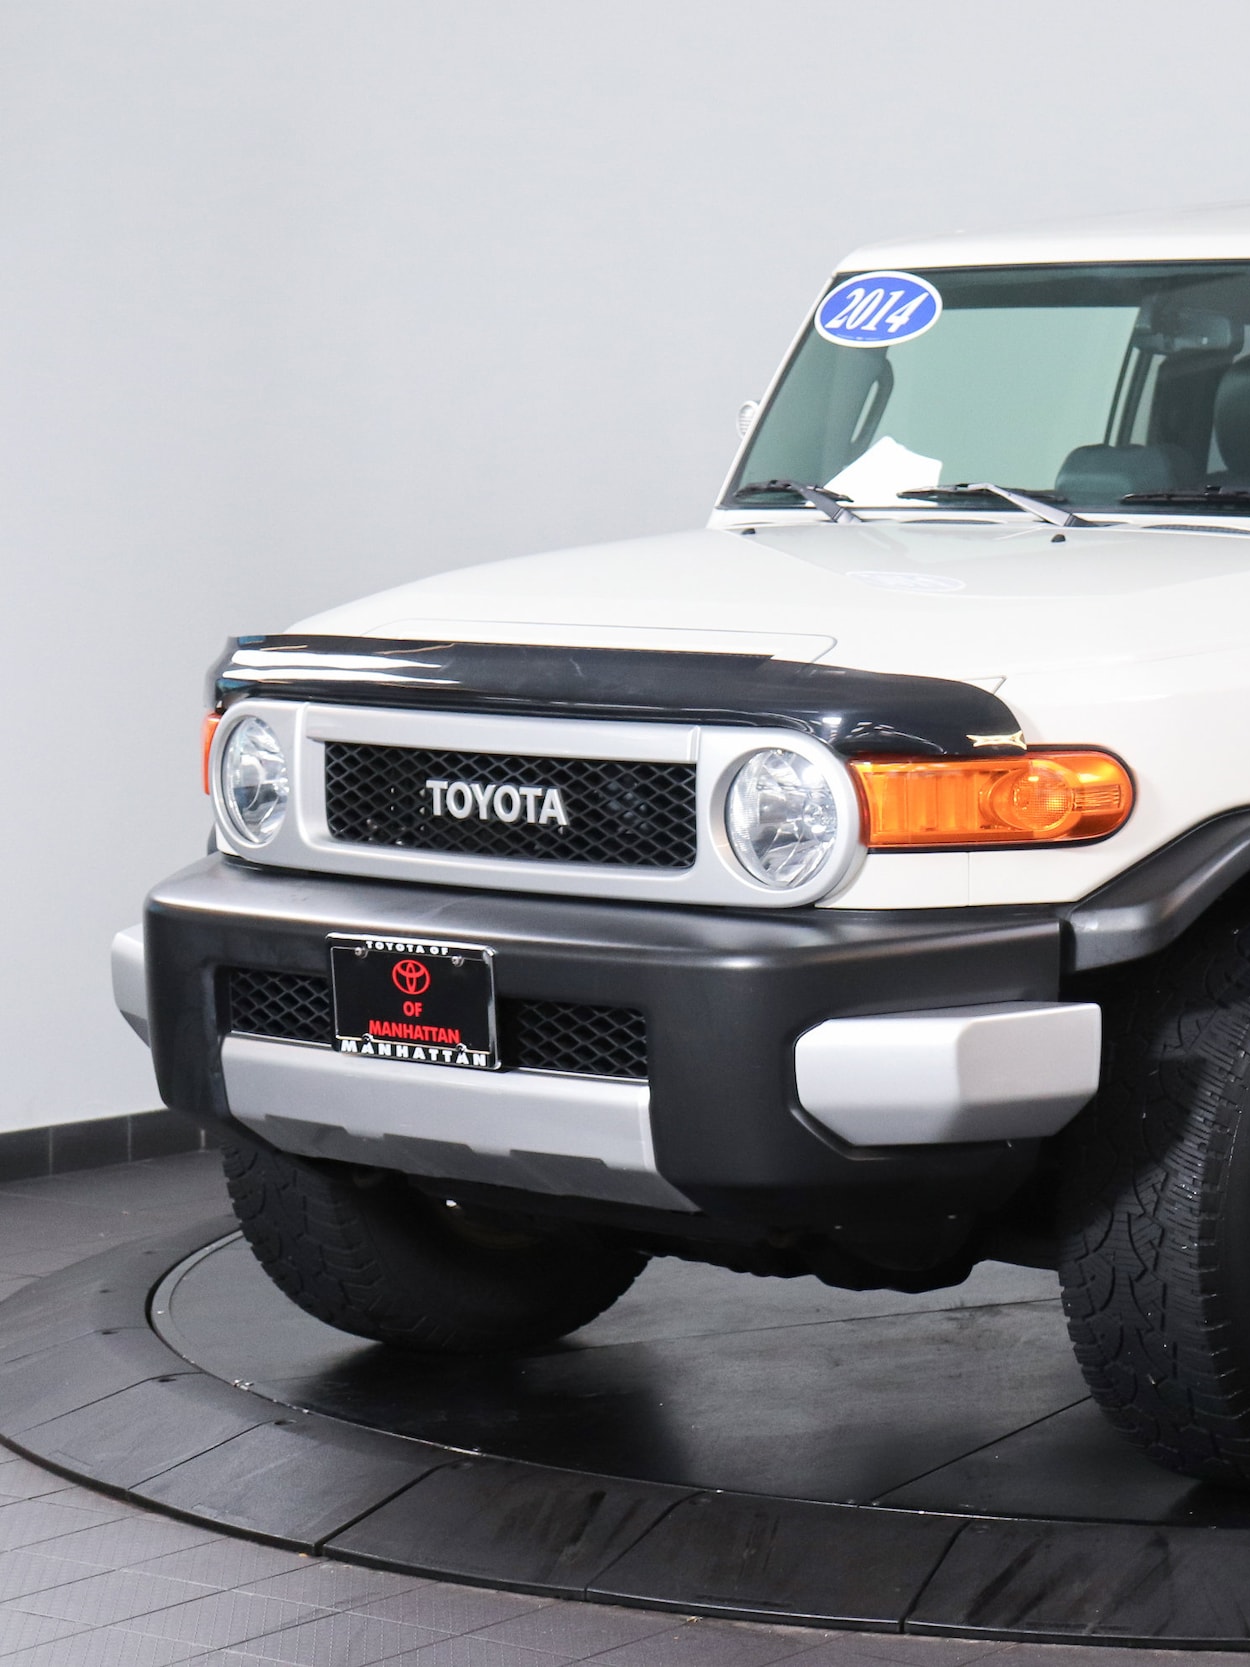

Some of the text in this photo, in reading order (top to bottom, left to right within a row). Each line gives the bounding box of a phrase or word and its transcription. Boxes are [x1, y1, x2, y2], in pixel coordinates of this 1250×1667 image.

[824, 288, 930, 333] 2014
[426, 779, 570, 826] TOYOTA
[366, 941, 450, 956] TOYOTA OF
[403, 1001, 423, 1017] OF
[369, 1020, 461, 1044] MANHATTAN
[341, 1039, 487, 1067] MANHATTAN
